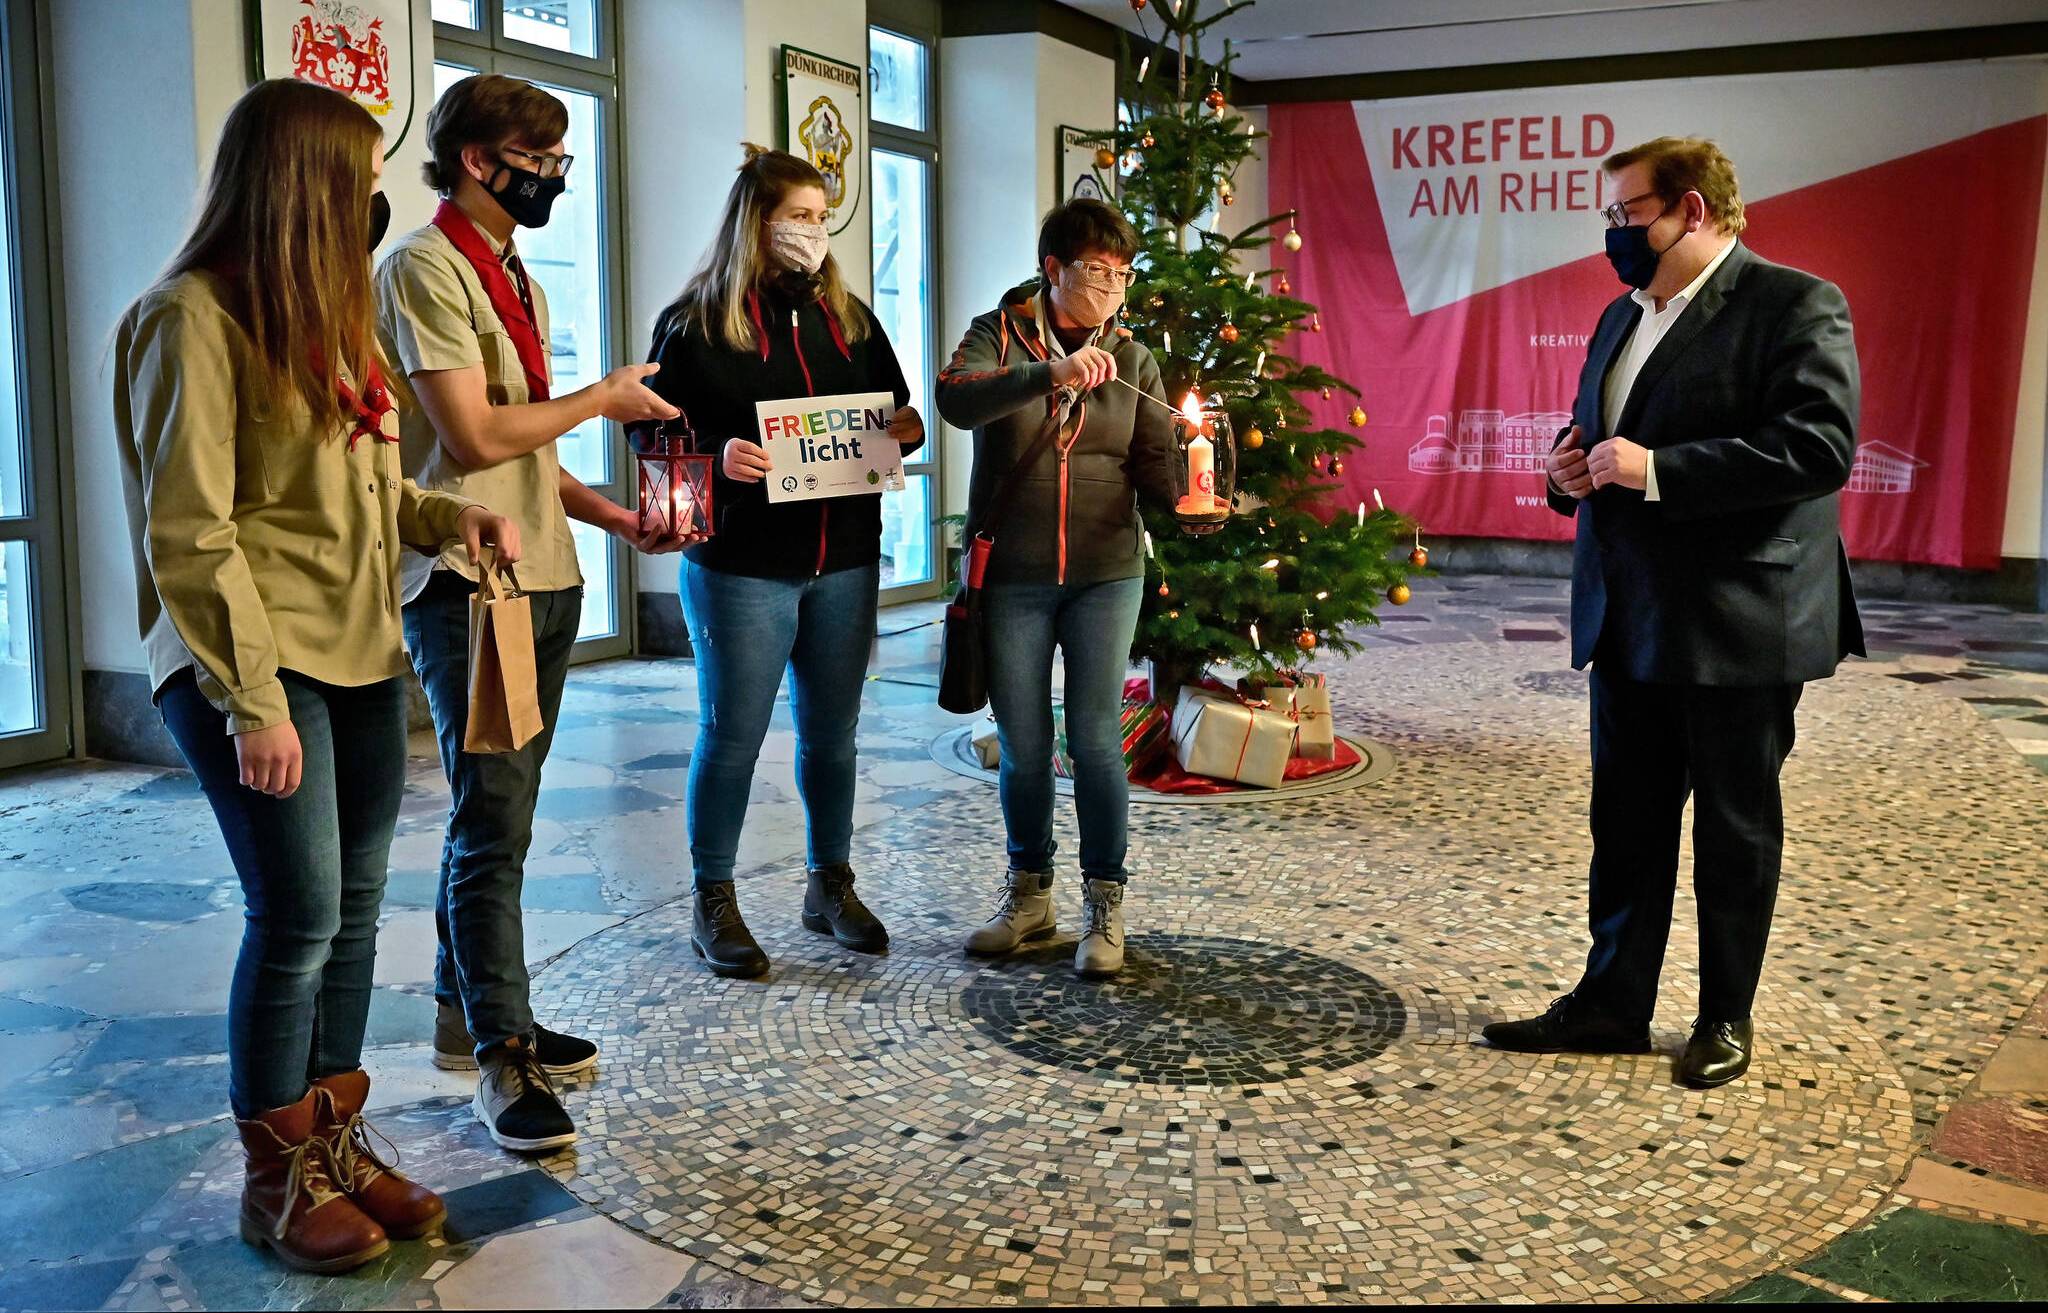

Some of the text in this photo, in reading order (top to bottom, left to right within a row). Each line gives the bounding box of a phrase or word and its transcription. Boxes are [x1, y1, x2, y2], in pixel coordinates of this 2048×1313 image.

[787, 51, 860, 87] DÜNKIRCHEN
[1392, 113, 1615, 169] KREFELD
[1409, 170, 1603, 218] AM RHEI
[799, 435, 863, 464] licht
